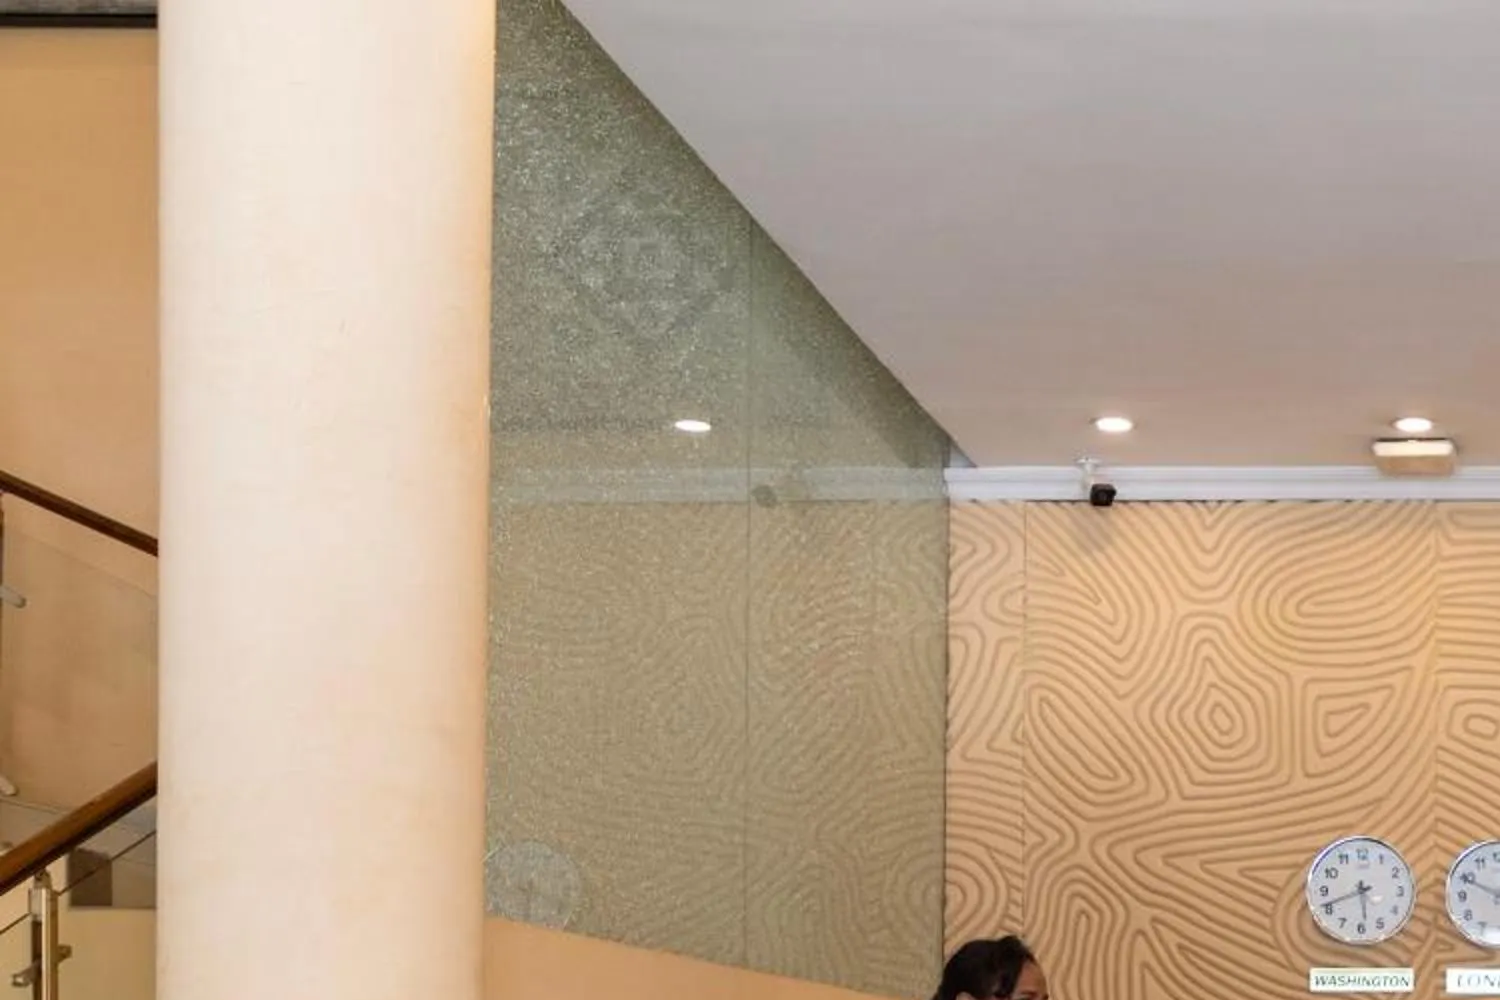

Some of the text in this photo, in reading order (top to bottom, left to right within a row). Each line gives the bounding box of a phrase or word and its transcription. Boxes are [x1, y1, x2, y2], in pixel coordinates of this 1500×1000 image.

[1339, 853, 1349, 864] 11
[1356, 848, 1368, 859] 12
[1379, 854, 1383, 864] 1
[1474, 857, 1485, 869] 11
[1325, 867, 1339, 879] 10
[1392, 866, 1399, 879] 2
[1319, 885, 1329, 896] 9
[1397, 885, 1404, 897] 3
[1458, 890, 1467, 902] 9
[1325, 903, 1333, 915] 8
[1337, 917, 1347, 928] 7
[1357, 923, 1366, 934] 6
[1376, 917, 1384, 929] 5
[1314, 975, 1410, 988] WASHINGTON
